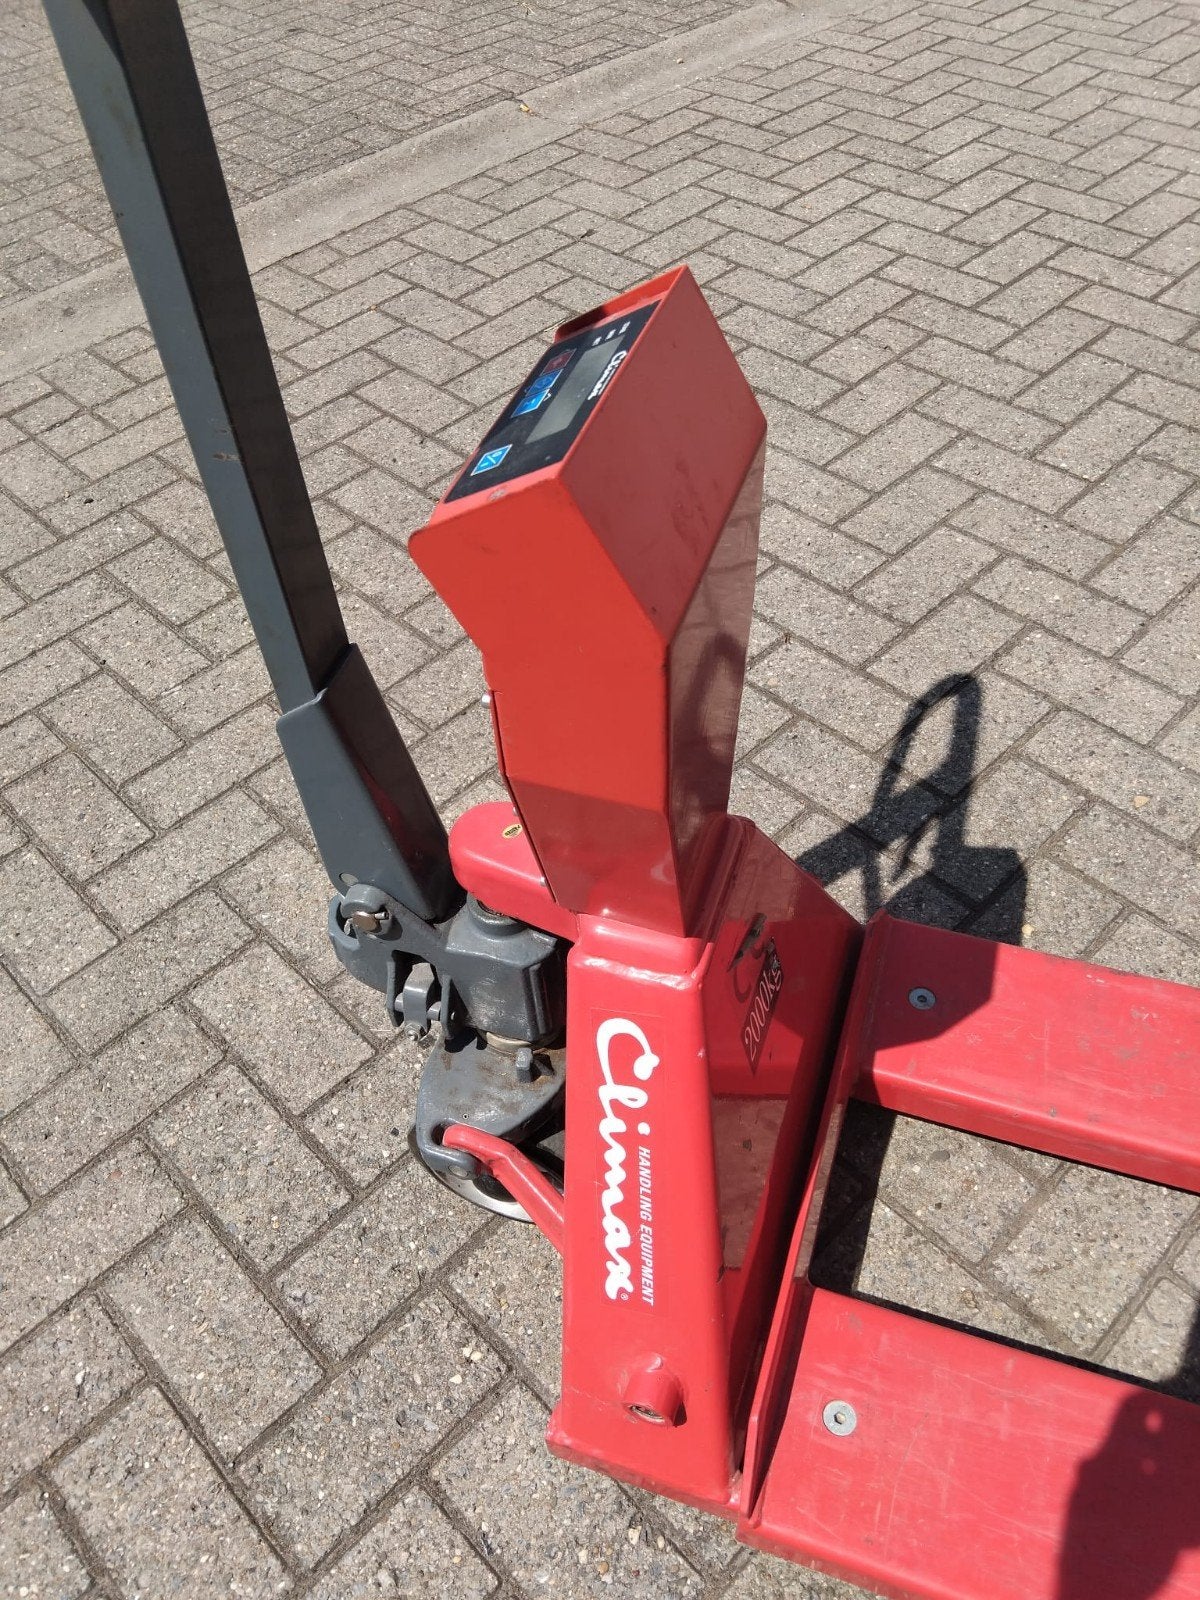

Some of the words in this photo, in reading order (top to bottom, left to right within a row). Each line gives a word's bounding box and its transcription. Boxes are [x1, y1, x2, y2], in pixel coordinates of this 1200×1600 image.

[597, 1018, 660, 1300] Climax
[638, 1145, 652, 1221] HANDLING
[639, 1224, 654, 1306] EQUIPMENT
